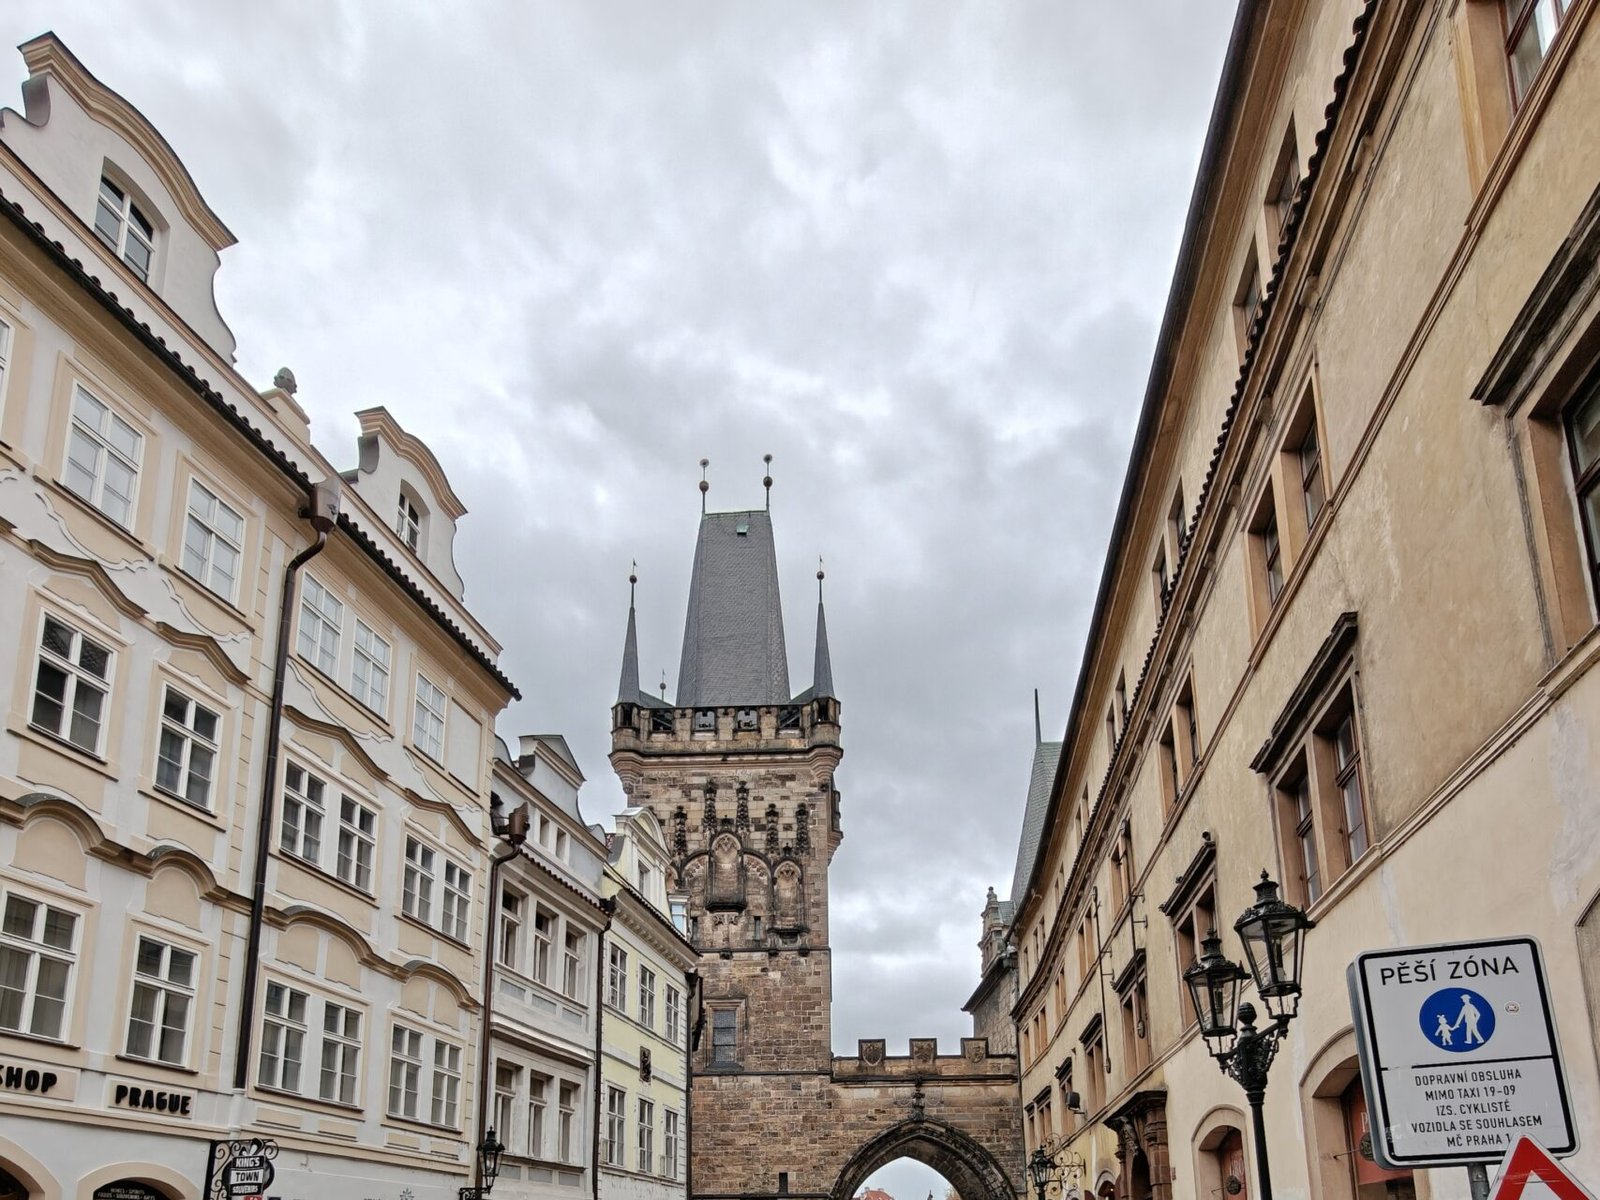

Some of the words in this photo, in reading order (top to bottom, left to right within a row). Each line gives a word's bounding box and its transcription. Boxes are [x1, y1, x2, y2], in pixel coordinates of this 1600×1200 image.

[1380, 958, 1436, 986] PĚŠÍ
[1447, 955, 1519, 980] ZÓNA
[1415, 1070, 1468, 1087] DOPRAVNÍ
[1471, 1068, 1522, 1082] OBSLUHA
[115, 1085, 192, 1115] PRAGUE
[1425, 1089, 1454, 1101] MIMO
[1458, 1087, 1480, 1099] TAXI
[1483, 1084, 1516, 1097] 19-09
[1436, 1104, 1457, 1116] IZS.
[1460, 1099, 1511, 1115] CYKLISTÉ
[1411, 1121, 1456, 1133] VOZIDLA
[1460, 1119, 1473, 1131] SE
[1476, 1115, 1542, 1130] SOUHLASEM
[1446, 1134, 1463, 1147] MČ
[1466, 1133, 1503, 1146] PRAHA
[235, 1157, 260, 1167] KING'S
[236, 1171, 260, 1182] TOWN
